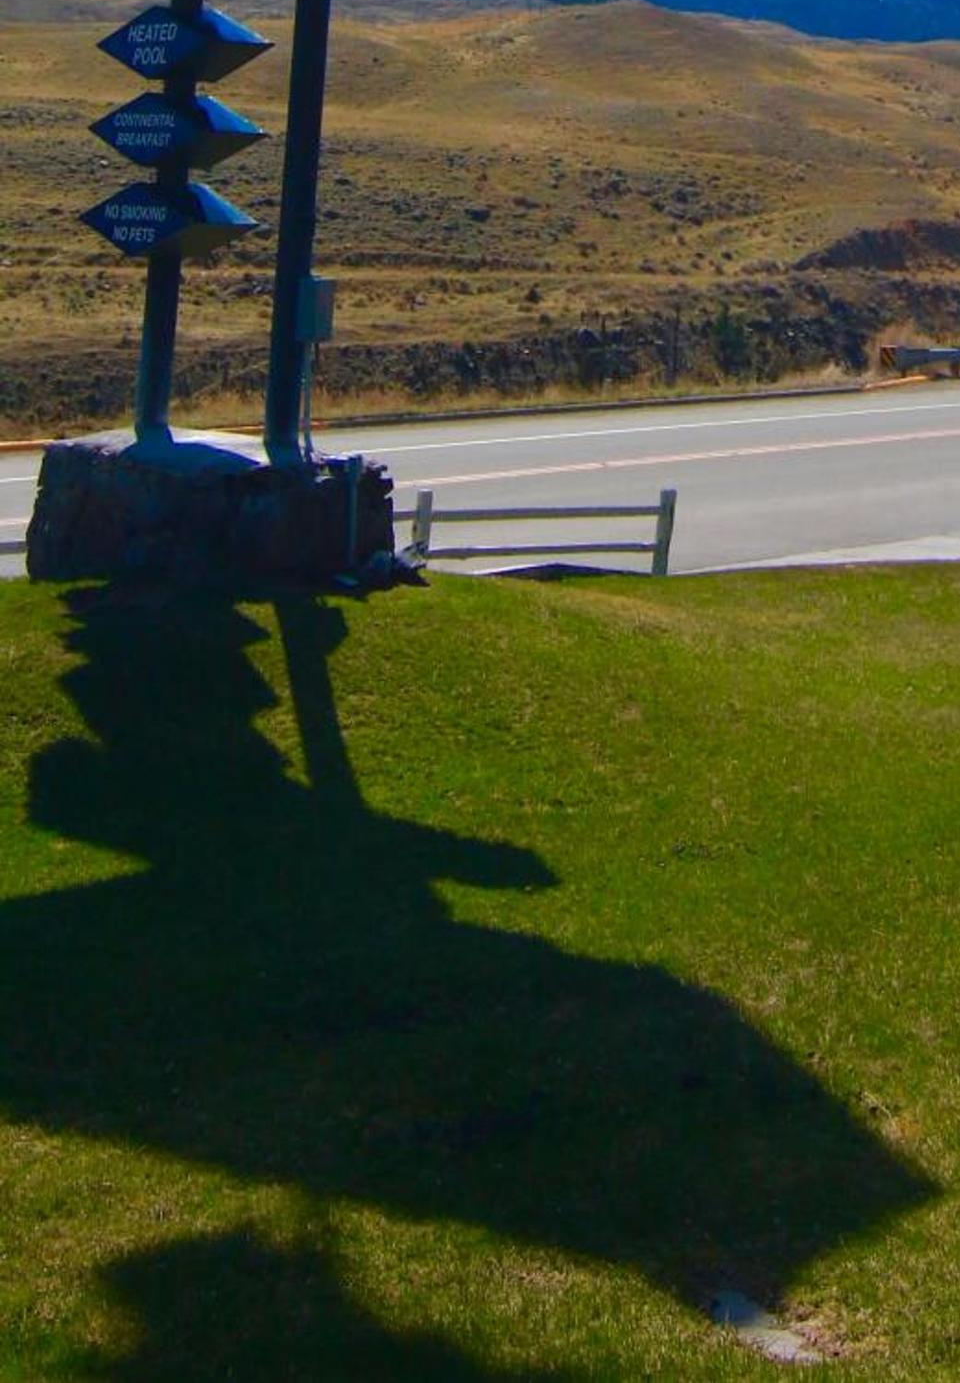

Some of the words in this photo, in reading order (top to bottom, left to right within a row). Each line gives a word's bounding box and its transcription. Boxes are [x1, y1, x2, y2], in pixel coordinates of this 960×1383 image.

[128, 23, 178, 43] HEATED
[132, 47, 168, 66] POOL
[114, 112, 175, 127] CONTINENTAL
[116, 132, 171, 146] BREAKFAST
[104, 204, 119, 219] NO
[121, 205, 166, 221] SMOKING
[112, 224, 127, 241] NO
[128, 227, 156, 243] PETS
